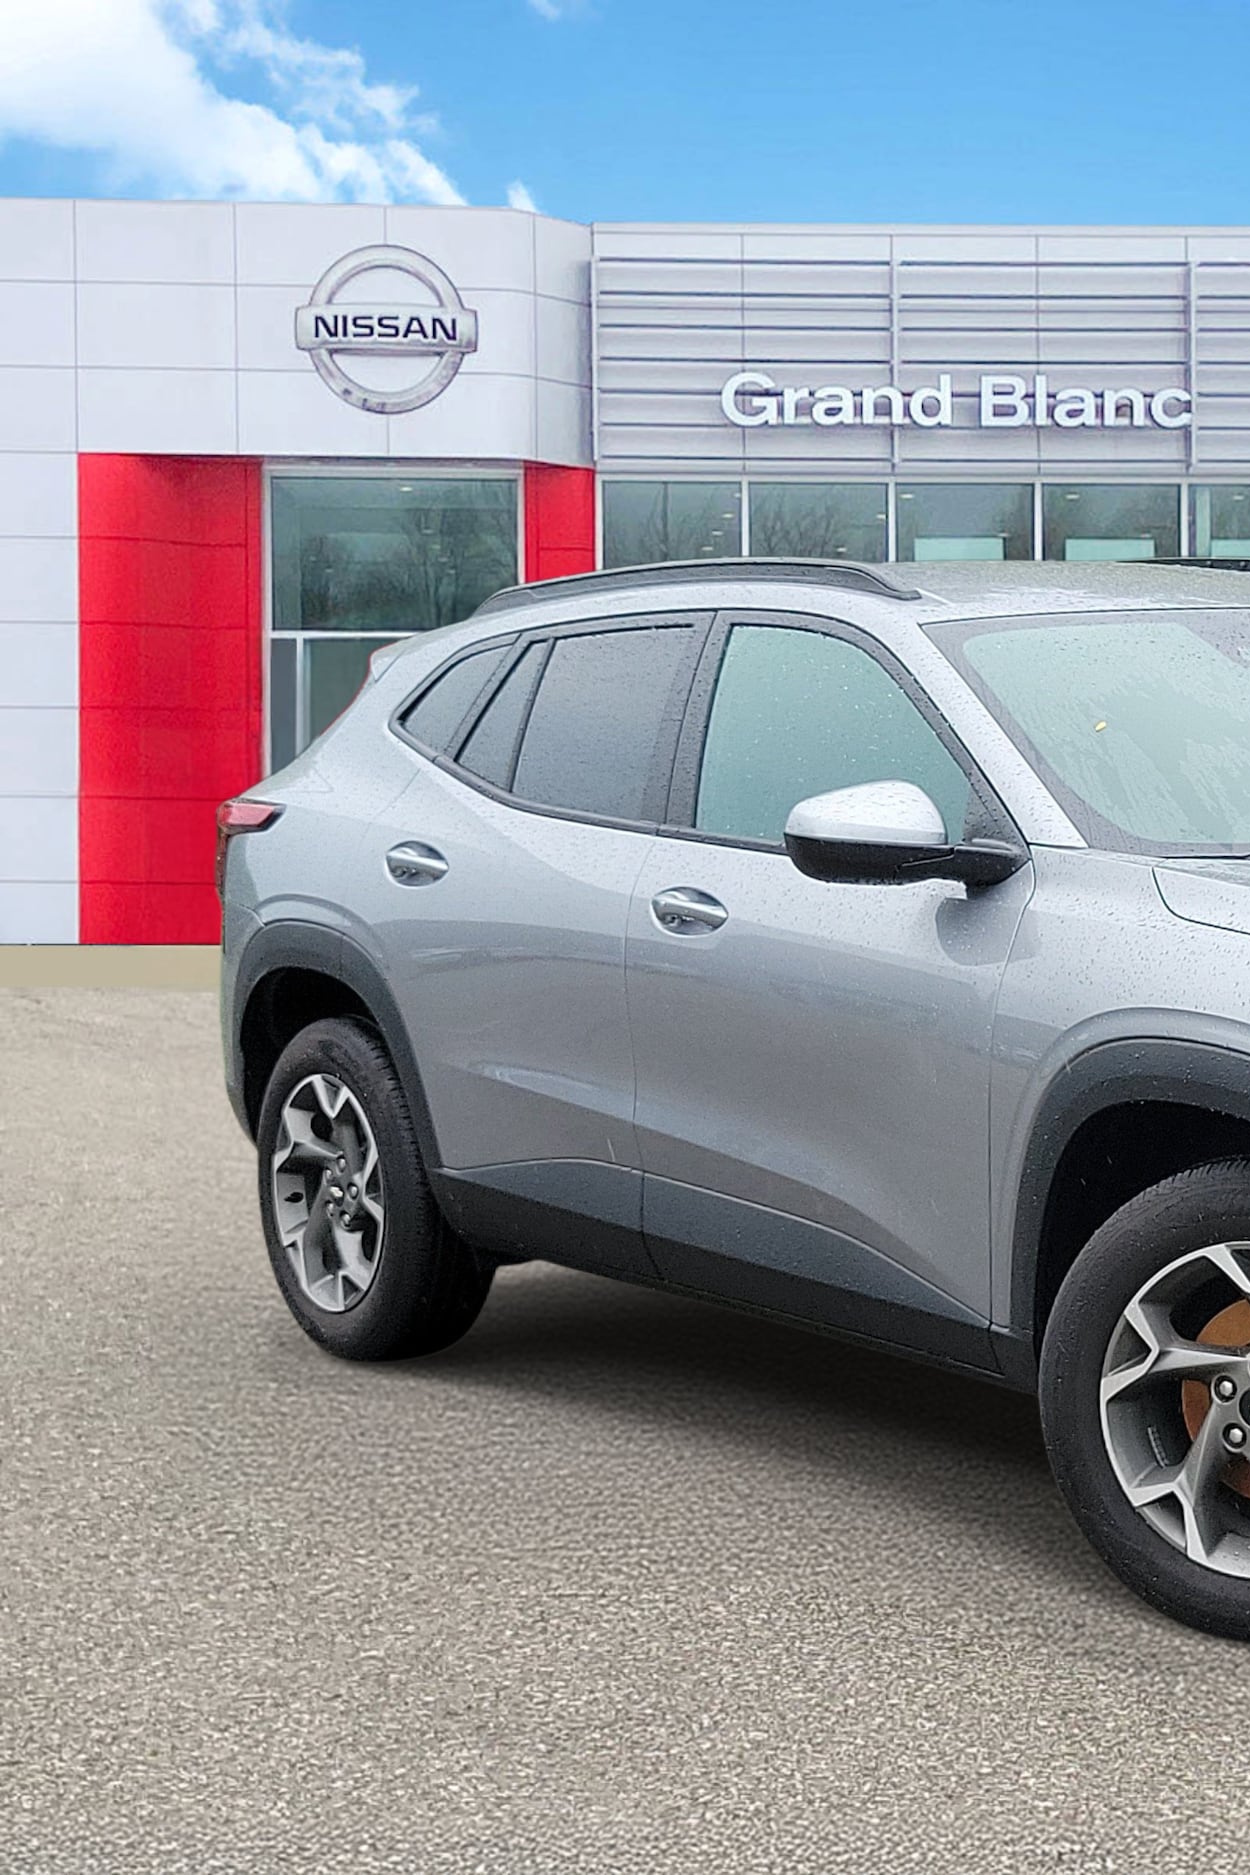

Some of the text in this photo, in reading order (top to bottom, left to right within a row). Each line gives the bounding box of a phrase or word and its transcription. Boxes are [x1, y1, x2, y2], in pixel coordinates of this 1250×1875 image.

[314, 315, 457, 341] NISSAN
[719, 371, 1192, 428] Grand Blanc
